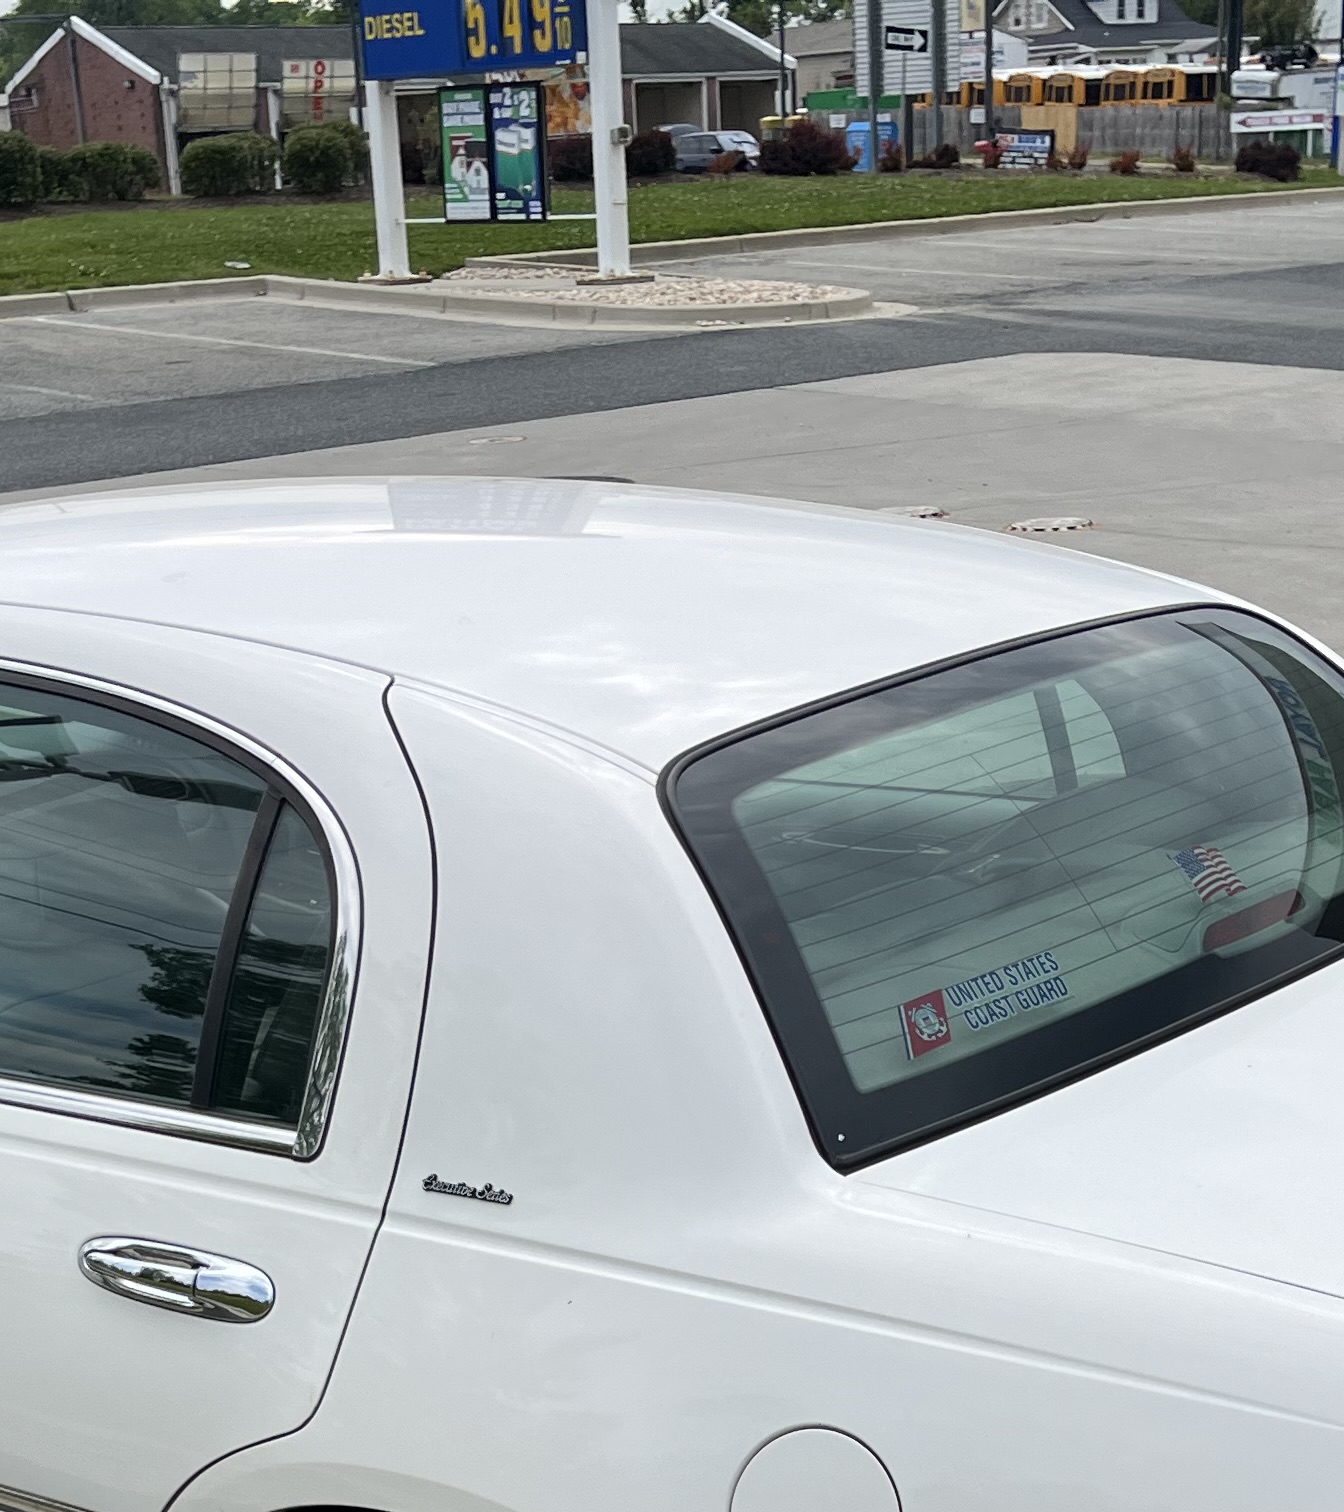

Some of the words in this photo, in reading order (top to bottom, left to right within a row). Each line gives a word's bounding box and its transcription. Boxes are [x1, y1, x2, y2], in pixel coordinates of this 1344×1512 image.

[364, 12, 426, 40] DIESEL
[466, 0, 553, 58] 5.49
[944, 970, 1006, 1008] UNITED
[1003, 951, 1060, 987] STATES
[963, 996, 1016, 1030] COAST
[1015, 976, 1069, 1011] GUARD
[422, 1173, 476, 1198] Executive
[475, 1183, 514, 1205] Series
